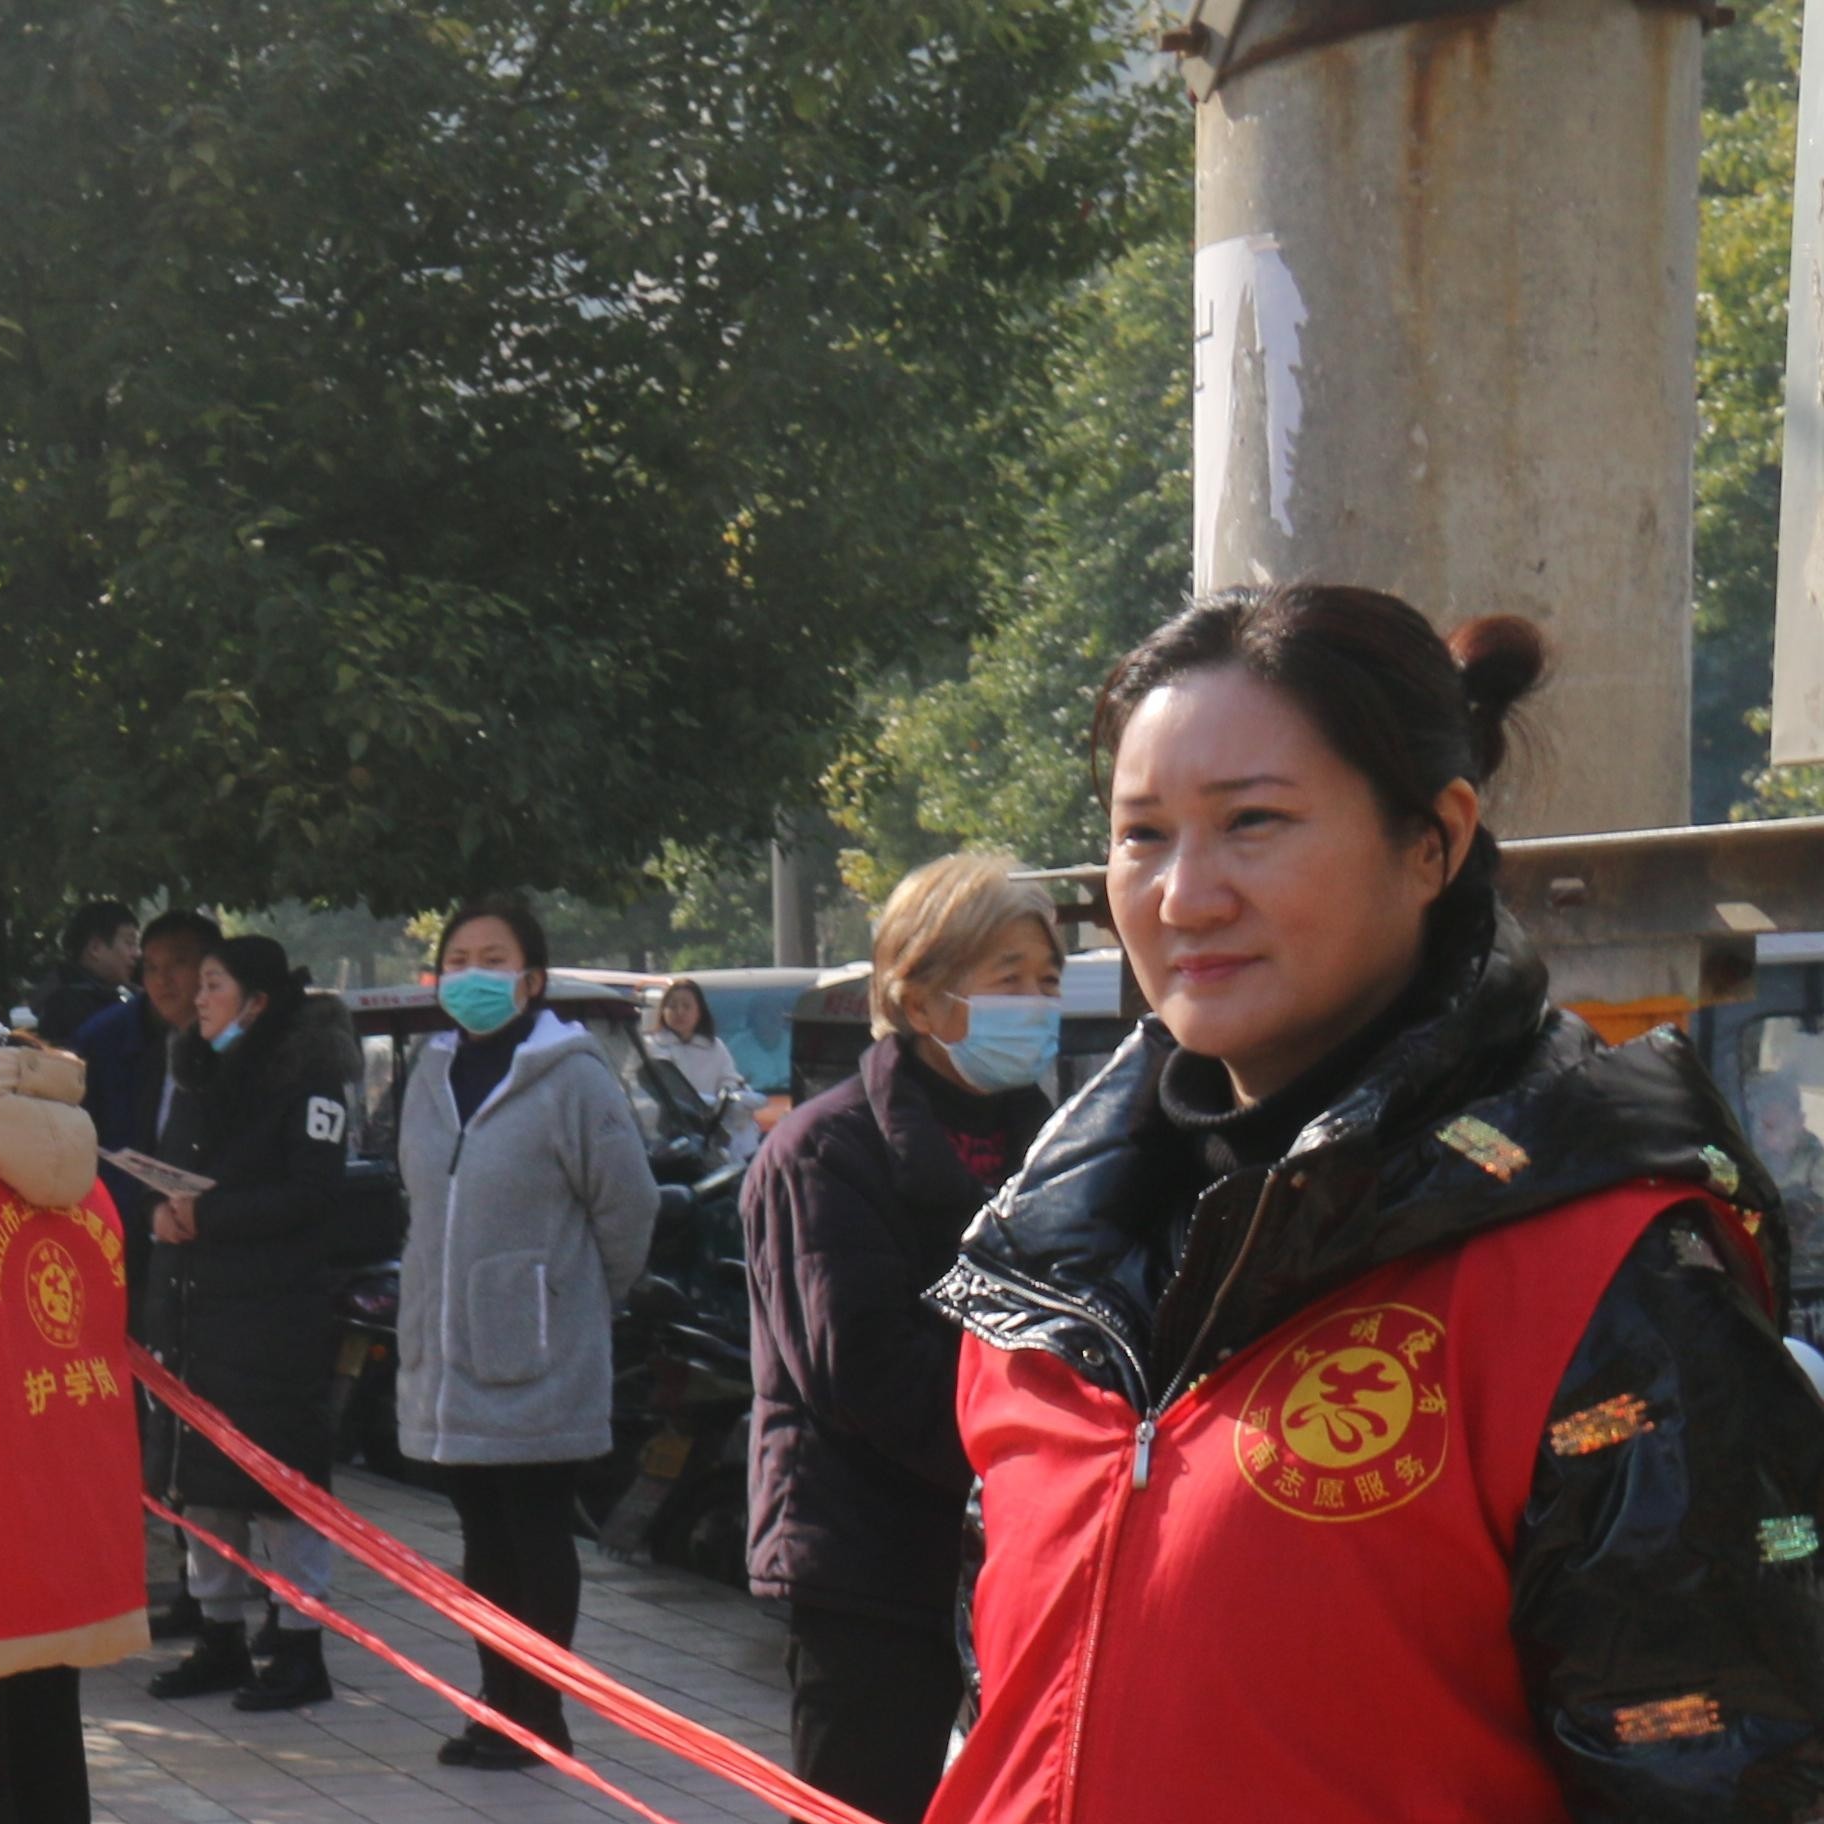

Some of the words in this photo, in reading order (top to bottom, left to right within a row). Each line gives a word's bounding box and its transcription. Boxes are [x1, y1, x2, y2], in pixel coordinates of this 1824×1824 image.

[306, 1095, 346, 1145] 67
[24, 1356, 120, 1415] 护学岗
[1245, 1406, 1426, 1509] 河南志愿服务
